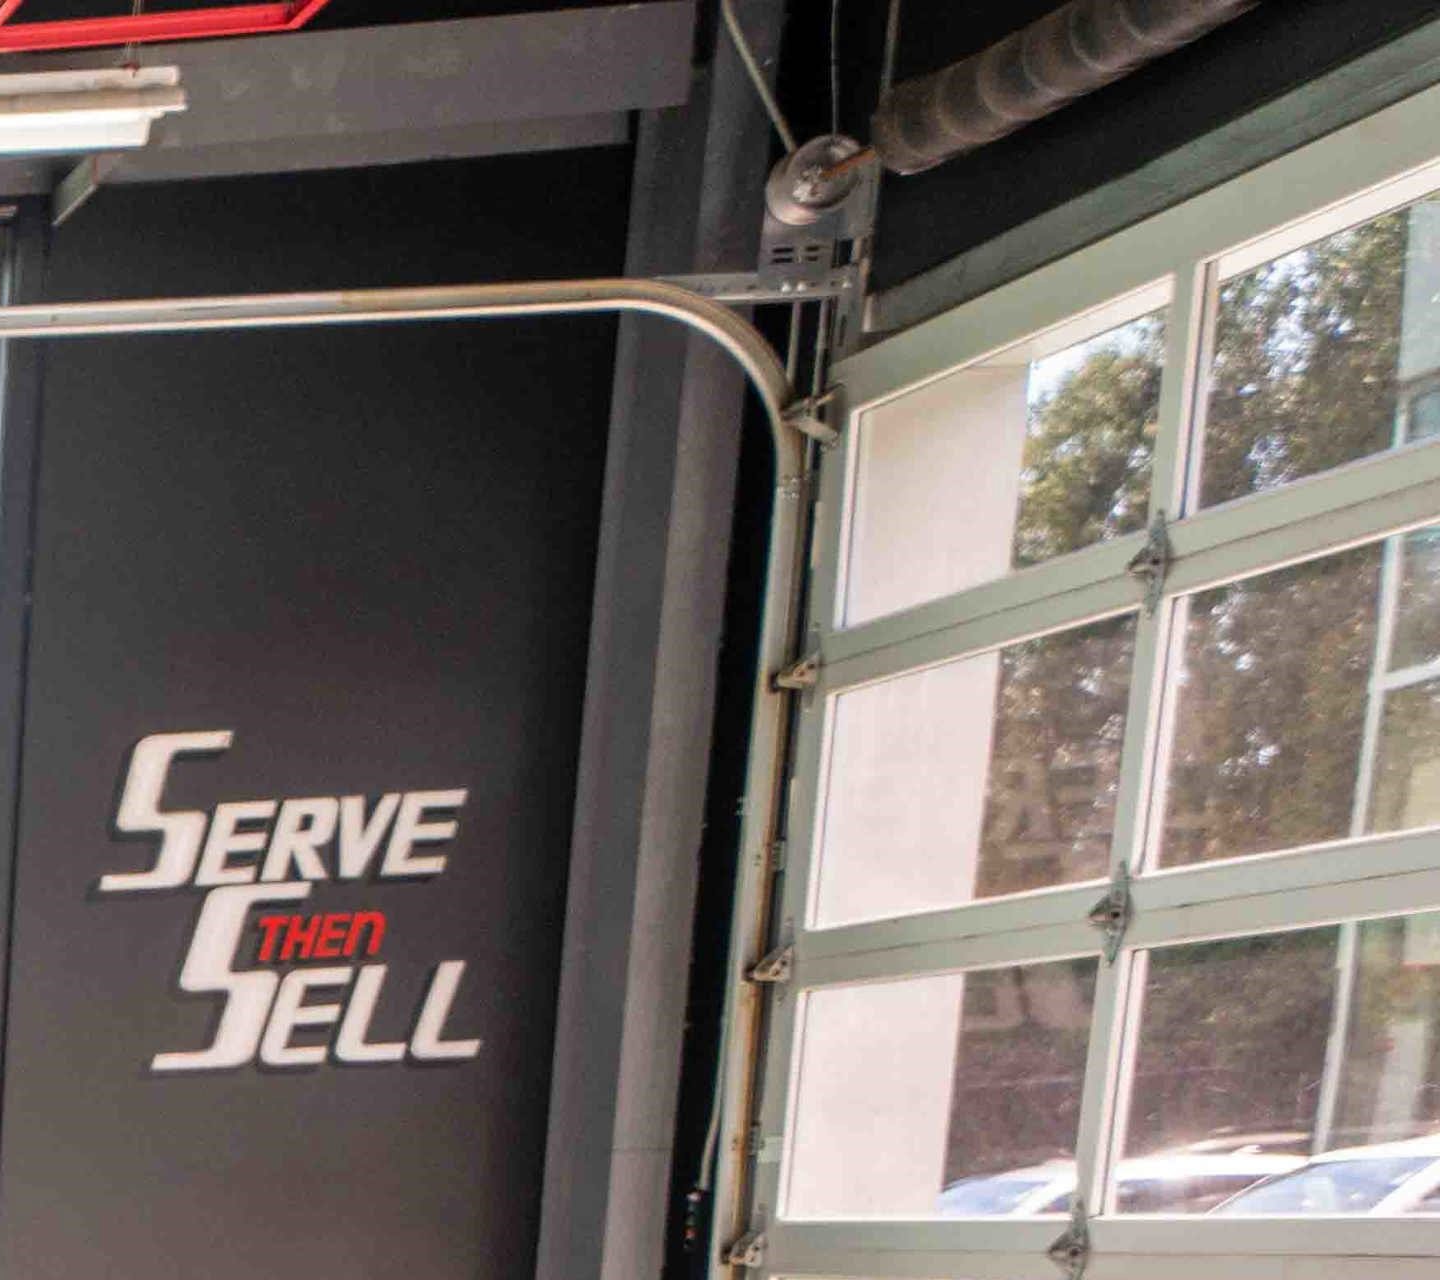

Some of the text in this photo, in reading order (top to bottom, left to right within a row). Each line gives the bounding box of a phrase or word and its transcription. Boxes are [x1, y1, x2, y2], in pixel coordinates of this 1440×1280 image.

[99, 731, 469, 891] SERVE
[150, 881, 482, 1072] SELL
[257, 910, 386, 961] THEN
